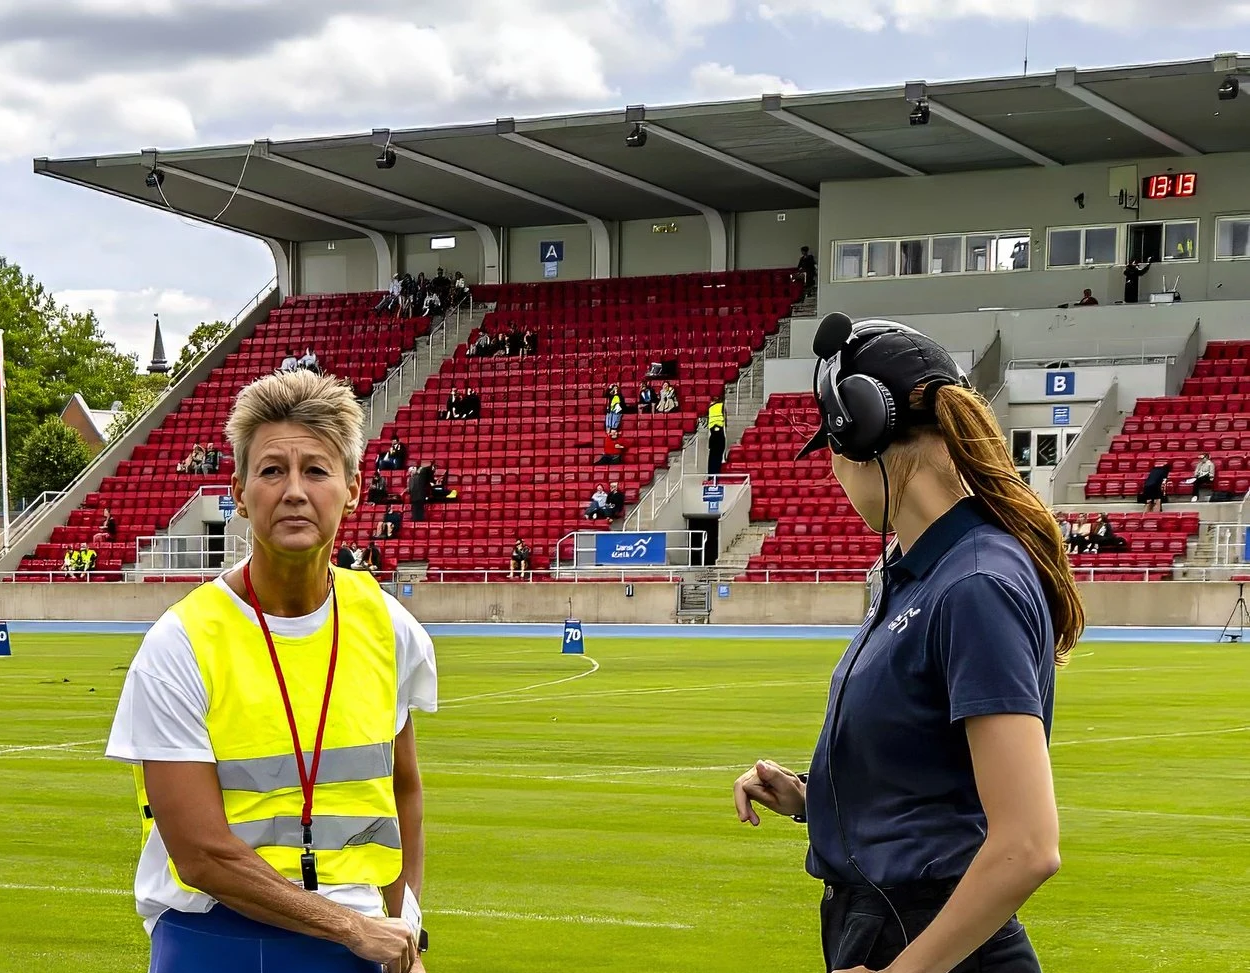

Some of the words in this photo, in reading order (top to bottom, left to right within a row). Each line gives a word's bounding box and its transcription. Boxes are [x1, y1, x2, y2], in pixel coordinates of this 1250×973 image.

[1150, 174, 1196, 197] 13:13
[545, 244, 558, 259] A
[1053, 375, 1067, 392] B
[565, 627, 582, 644] 70
